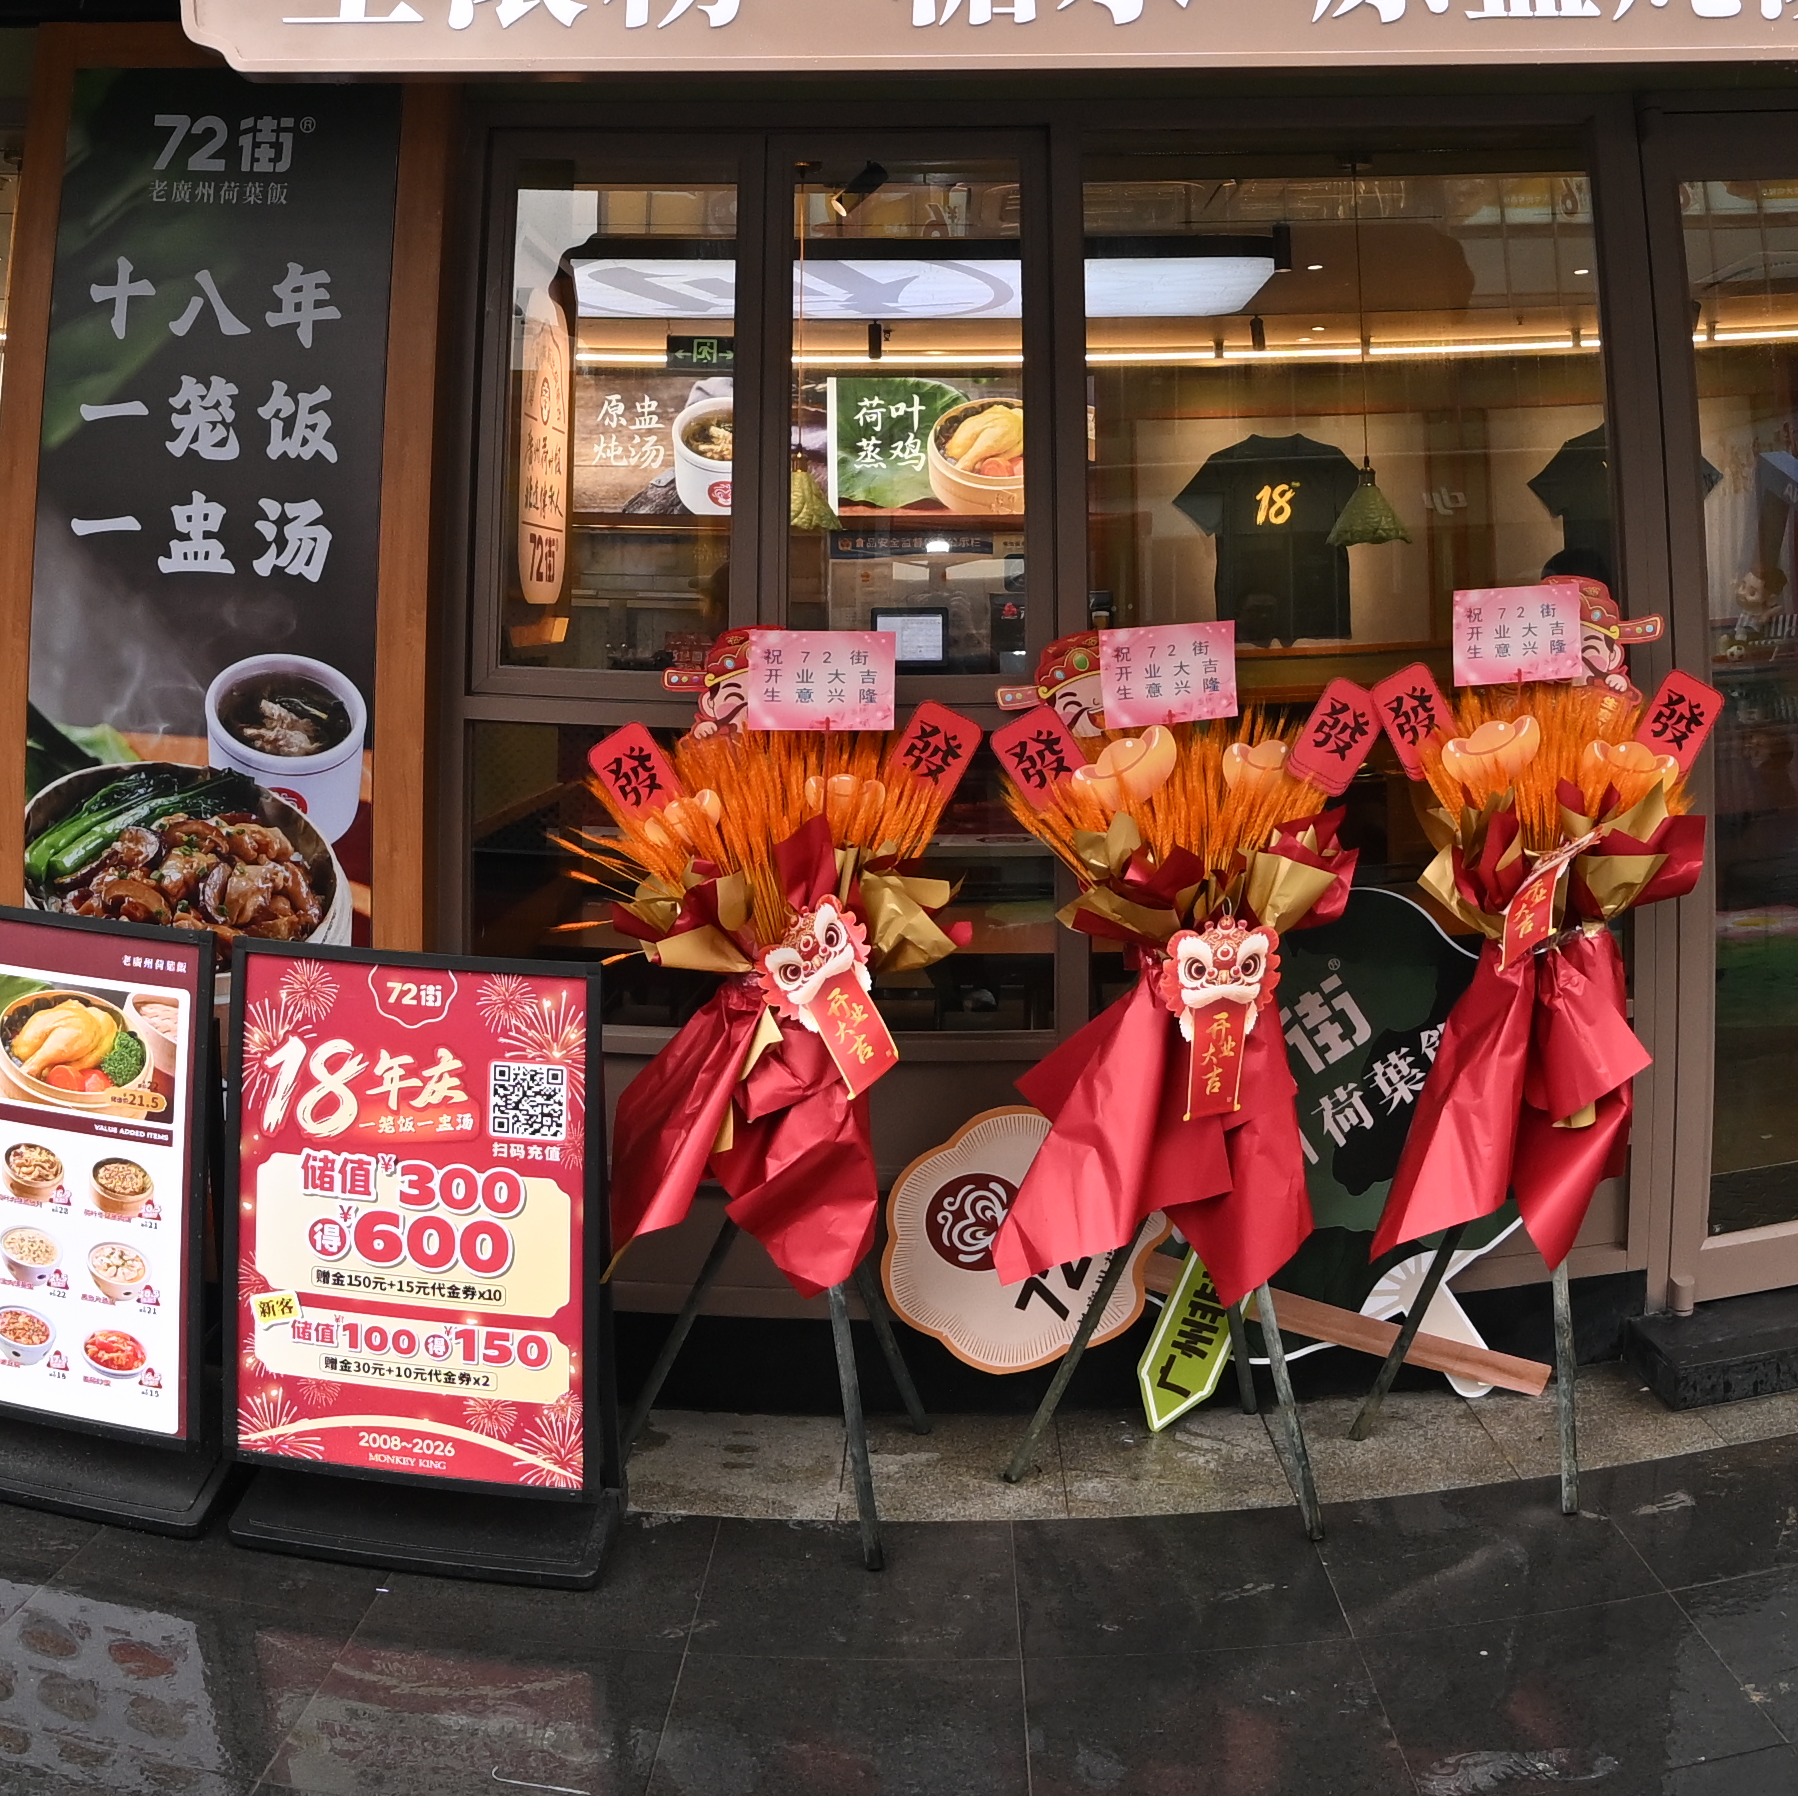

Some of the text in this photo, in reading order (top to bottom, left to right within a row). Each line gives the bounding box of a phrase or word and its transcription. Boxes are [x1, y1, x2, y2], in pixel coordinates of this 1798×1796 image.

[148, 179, 288, 206] 老廣州荷葉飯
[89, 256, 342, 349] 十八年
[80, 375, 339, 463] 一笼饭
[597, 394, 665, 430] 原盅
[853, 394, 927, 434] 荷叶
[593, 433, 665, 469] 炖汤
[853, 435, 927, 472] 蒸鸡
[1255, 483, 1292, 526] 18
[71, 491, 333, 584] 一盅汤
[856, 537, 981, 549] 食品安全监督公示栏
[1466, 620, 1566, 642] 开业大吉
[1466, 639, 1567, 660] 生意兴隆
[763, 668, 878, 686] 开业大吉
[1114, 658, 1219, 682] 开业大吉
[763, 686, 878, 704] 生意兴隆
[1115, 677, 1221, 702] 生意兴隆
[1311, 696, 1371, 761] 發
[1384, 686, 1437, 747] 發
[1649, 688, 1705, 751] 發
[904, 721, 965, 786] 發
[1004, 729, 1073, 790] 發
[603, 746, 662, 808] 發
[385, 980, 443, 1008] 72街
[825, 988, 876, 1066] 开业大吉
[1200, 1011, 1237, 1096] 开业大吉
[94, 1123, 169, 1142] VALUE ADDED ITEMS
[358, 1110, 475, 1134] 一笼饭一盅汤
[492, 1141, 561, 1163] 扫码充值
[300, 1149, 377, 1201] 储值
[308, 1218, 347, 1259] 得
[257, 1297, 295, 1319] 新客
[290, 1319, 336, 1348] 储值
[425, 1334, 450, 1360] 得
[368, 1451, 447, 1472] MONKEY KING
